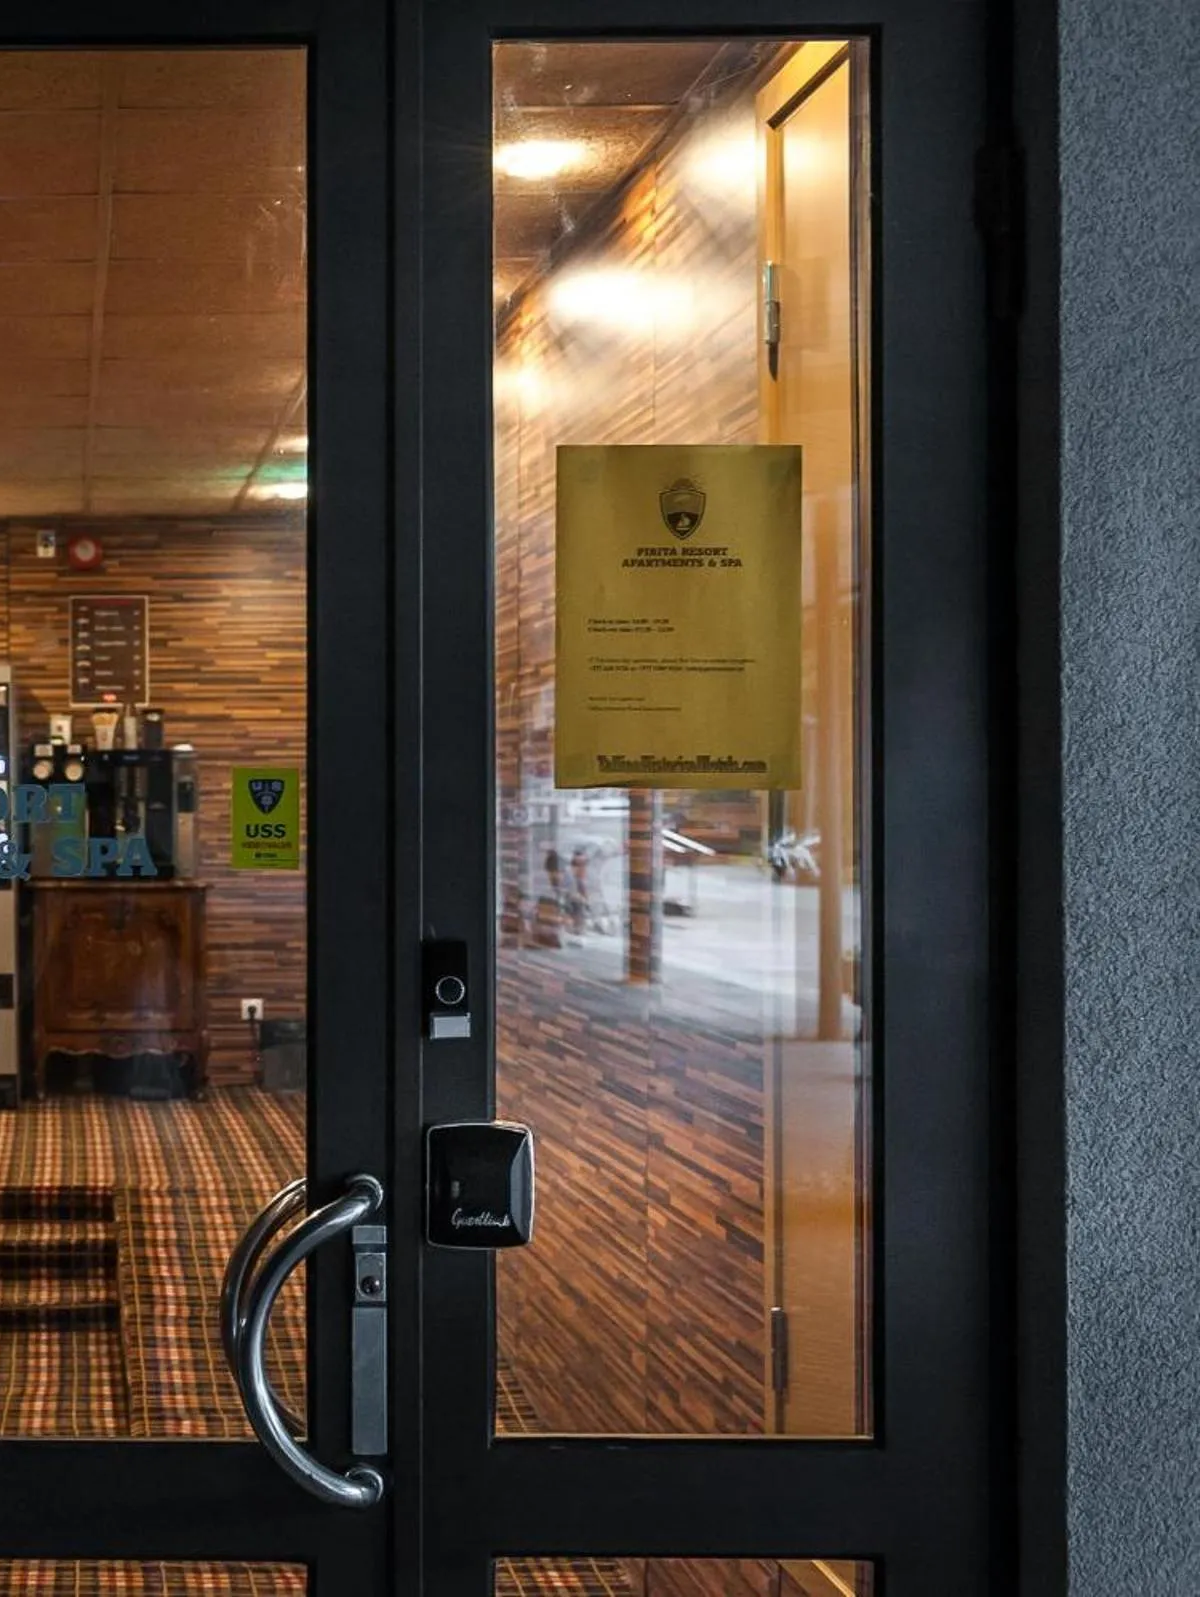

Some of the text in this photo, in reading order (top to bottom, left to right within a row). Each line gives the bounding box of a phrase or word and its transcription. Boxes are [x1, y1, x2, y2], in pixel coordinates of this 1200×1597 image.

[637, 547, 728, 557] PIRITA RESORT
[621, 558, 705, 568] APARTMENTS
[719, 558, 743, 568] SPA
[245, 823, 287, 839] USS
[51, 836, 158, 877] SPA
